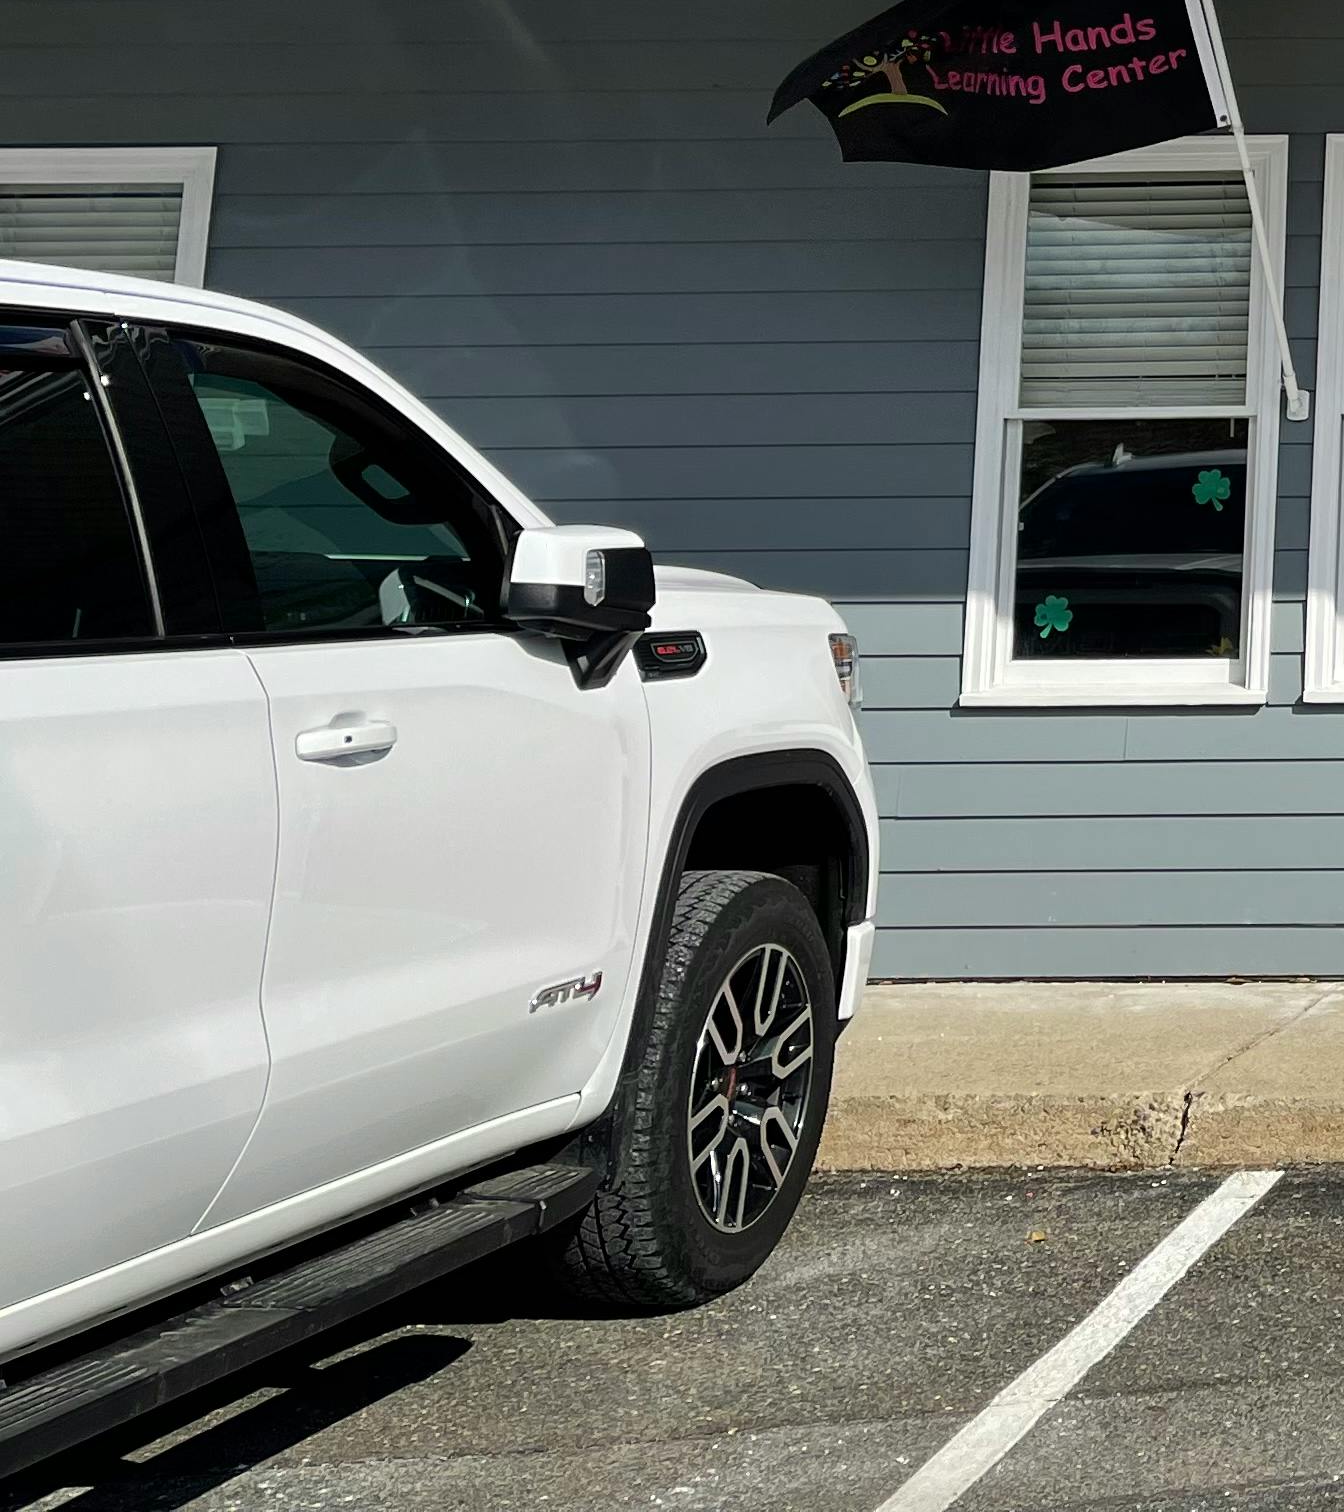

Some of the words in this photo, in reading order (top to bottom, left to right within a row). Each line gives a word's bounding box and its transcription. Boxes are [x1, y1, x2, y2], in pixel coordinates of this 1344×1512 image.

[1032, 12, 1158, 55] Hands
[926, 64, 1048, 105] Learning
[1062, 47, 1187, 94] Center
[529, 971, 603, 1015] AT4
